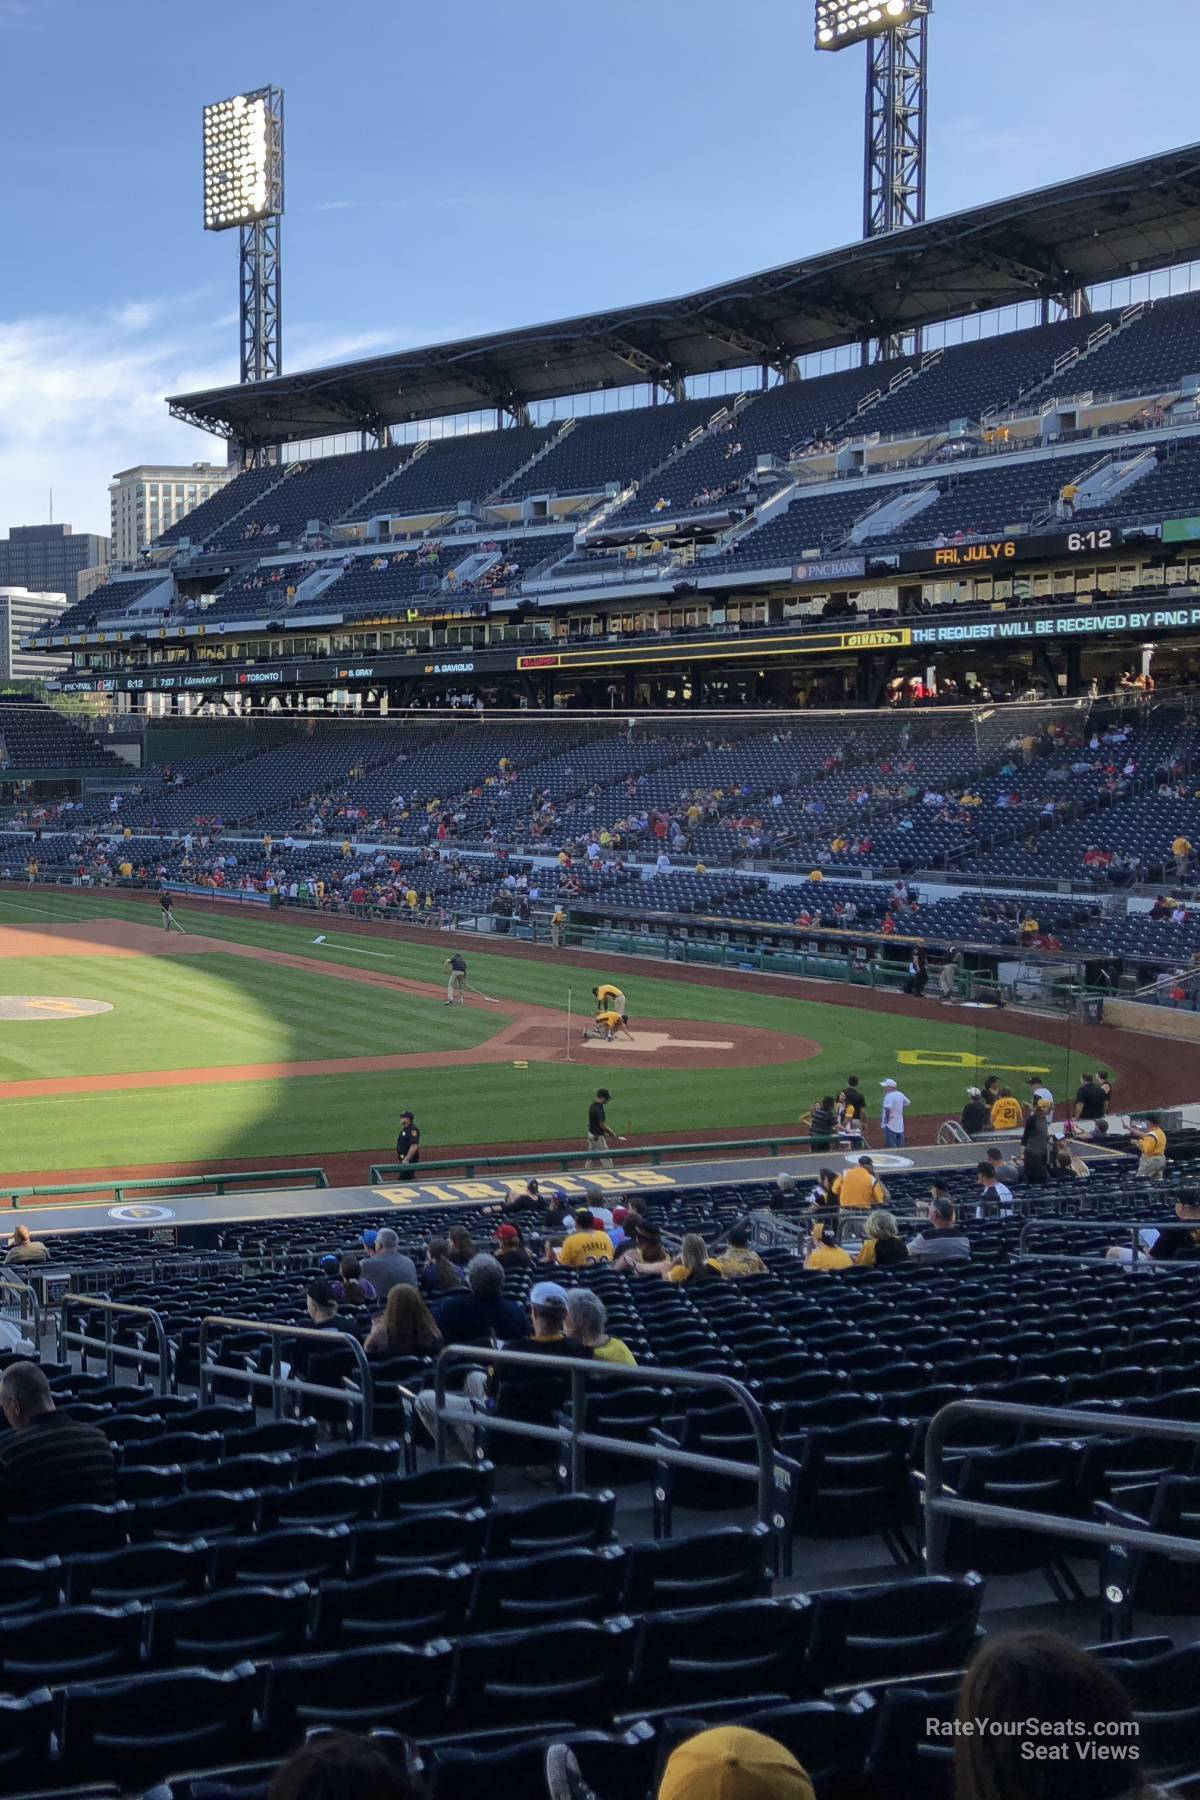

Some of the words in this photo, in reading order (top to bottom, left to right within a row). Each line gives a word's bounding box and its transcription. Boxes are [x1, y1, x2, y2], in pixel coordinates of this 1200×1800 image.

[1068, 530, 1112, 551] 6:12
[935, 547, 960, 565] FRI,
[964, 545, 1001, 562] JULY
[1004, 542, 1015, 557] 6
[808, 563, 830, 578] PNC
[831, 560, 862, 575] BANK
[913, 629, 936, 642] THE
[938, 625, 996, 640] REQUEST
[999, 623, 1033, 637] WILL
[1035, 621, 1054, 633] BE
[1056, 615, 1127, 632] RECEIVED
[1130, 613, 1151, 627] BY
[1154, 610, 1188, 626] PNC
[442, 664, 474, 672] GAVIGLIO
[127, 680, 144, 688] 6:12
[161, 678, 175, 687] 7:07
[247, 673, 279, 682] TORONTO
